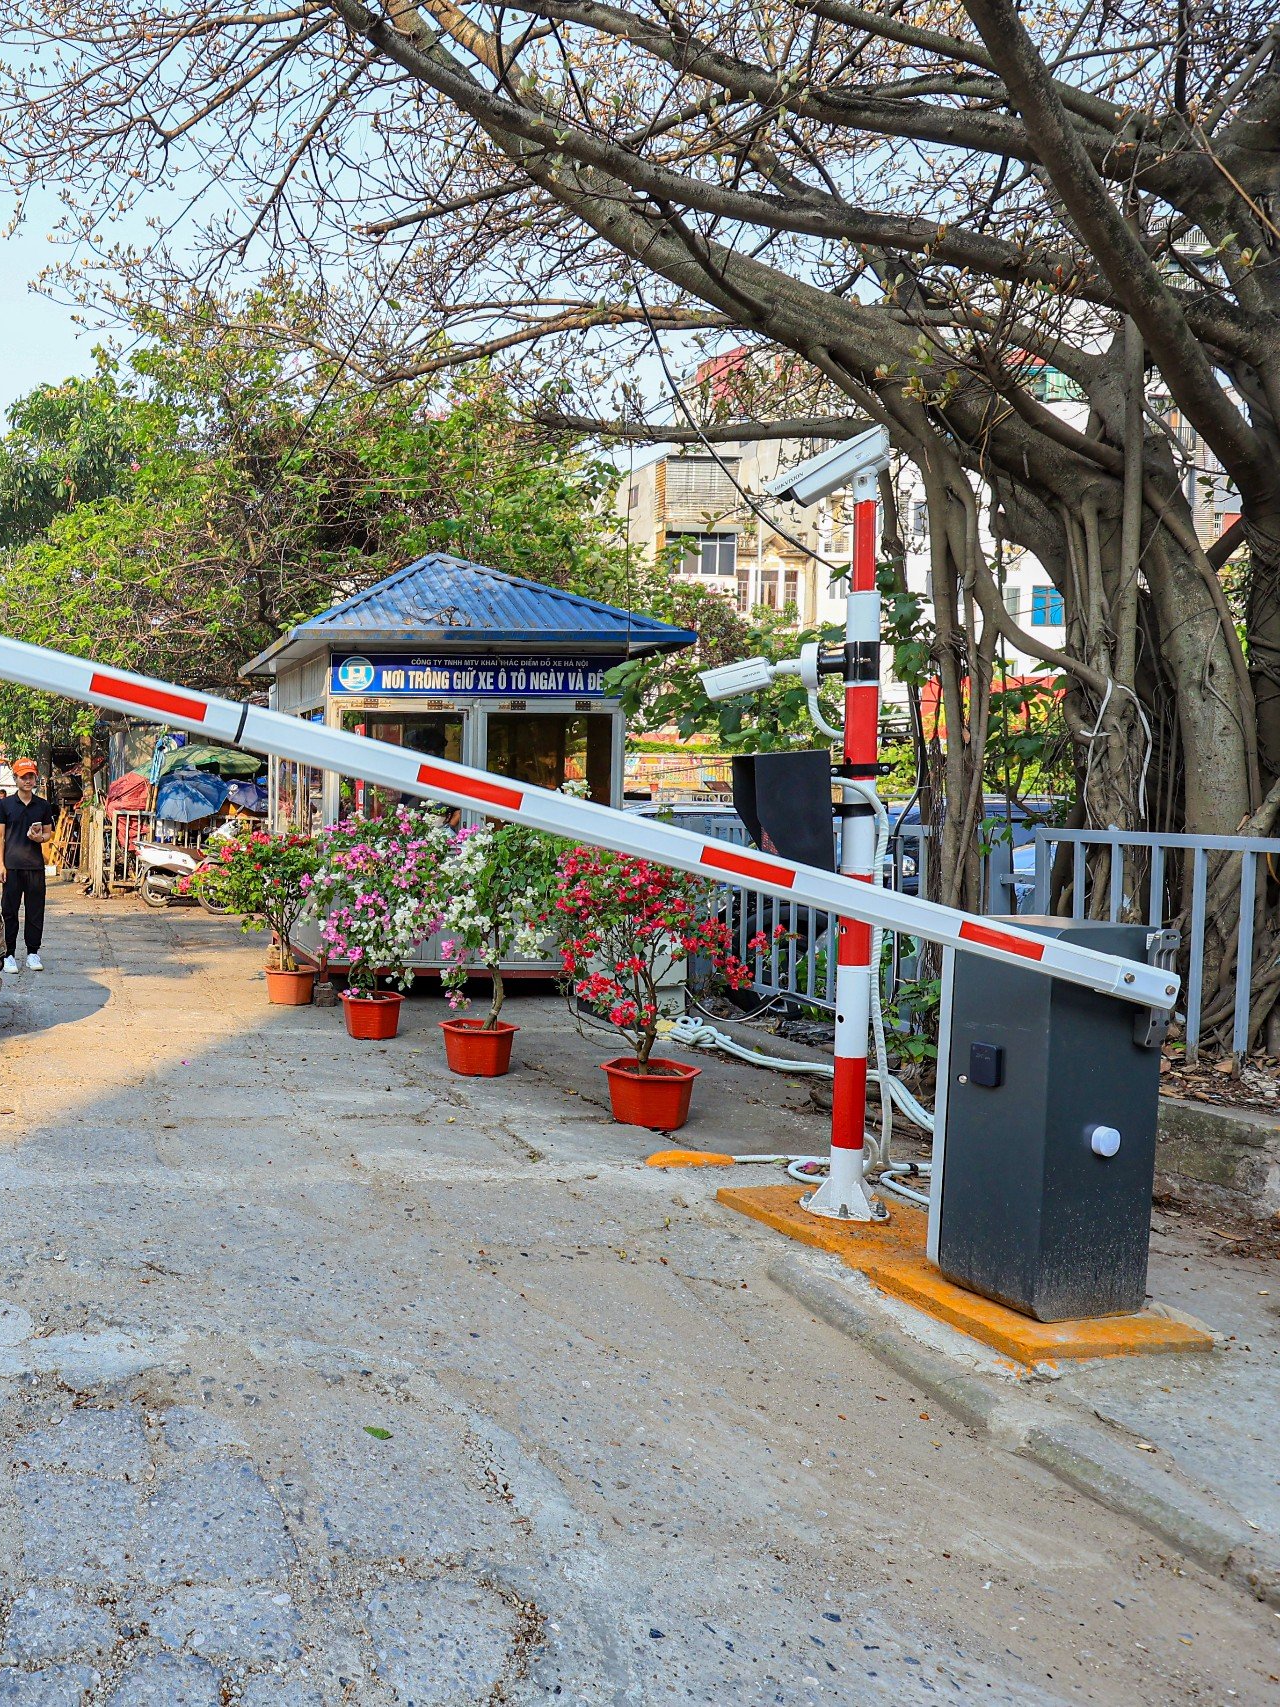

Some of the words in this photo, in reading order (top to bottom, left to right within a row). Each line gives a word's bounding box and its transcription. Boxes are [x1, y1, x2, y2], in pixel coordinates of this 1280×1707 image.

[774, 472, 804, 491] HIKVISION
[411, 657, 431, 666] CÔNG
[381, 669, 405, 689] NƠI
[408, 667, 450, 690] TRÔNG
[453, 666, 476, 690] GIỮ
[477, 671, 495, 690] XE
[498, 668, 507, 690] Ô
[510, 668, 526, 690] TÔ
[530, 669, 565, 690] NGÀY
[568, 669, 584, 691] VÀ
[587, 669, 608, 691] ĐÊ
